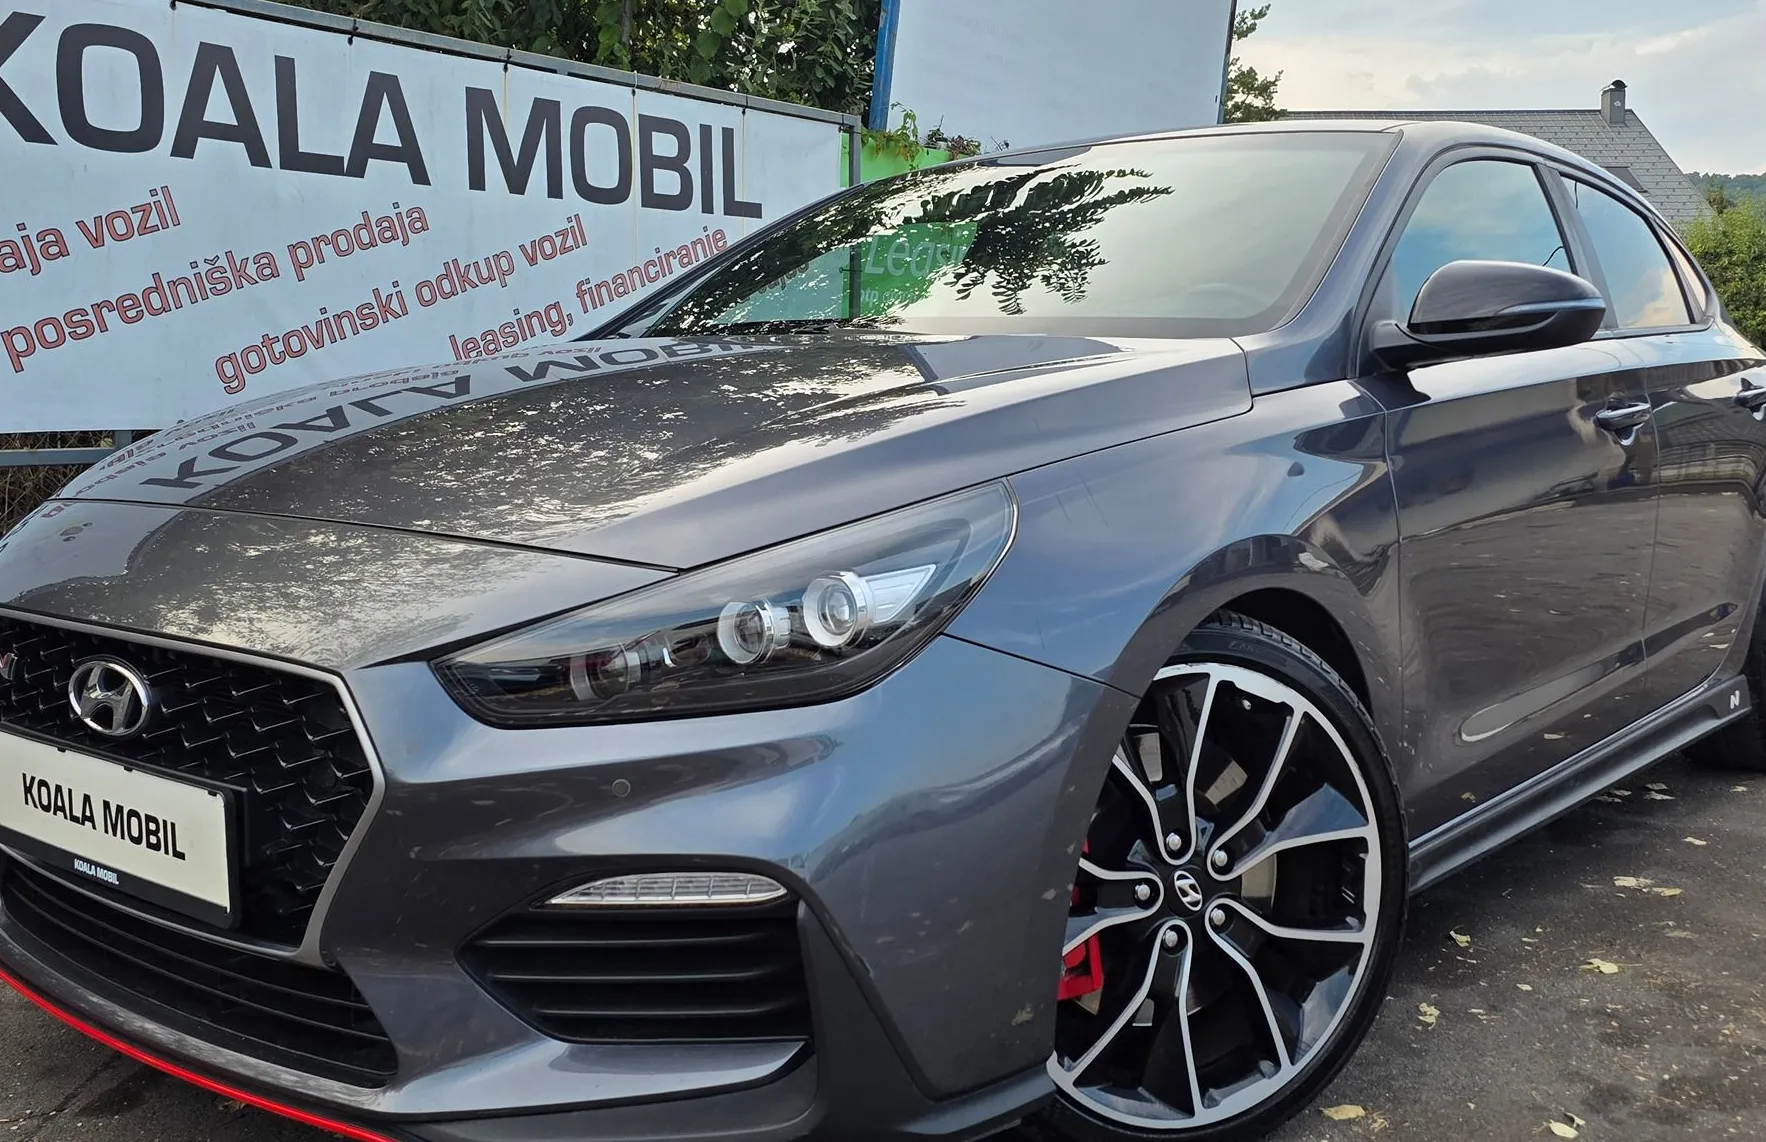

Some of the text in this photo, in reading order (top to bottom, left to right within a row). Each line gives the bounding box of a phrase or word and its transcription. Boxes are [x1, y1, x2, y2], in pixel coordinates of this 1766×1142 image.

[465, 86, 763, 219] MOBIL
[75, 185, 181, 249] vozil
[1, 202, 430, 373] posredniška prodaja
[214, 213, 588, 394] gotovinski odkup vozil
[448, 300, 574, 362] leasing,
[22, 772, 186, 861] KOALA MOBIL
[74, 858, 120, 885] KOALA MOBIL
